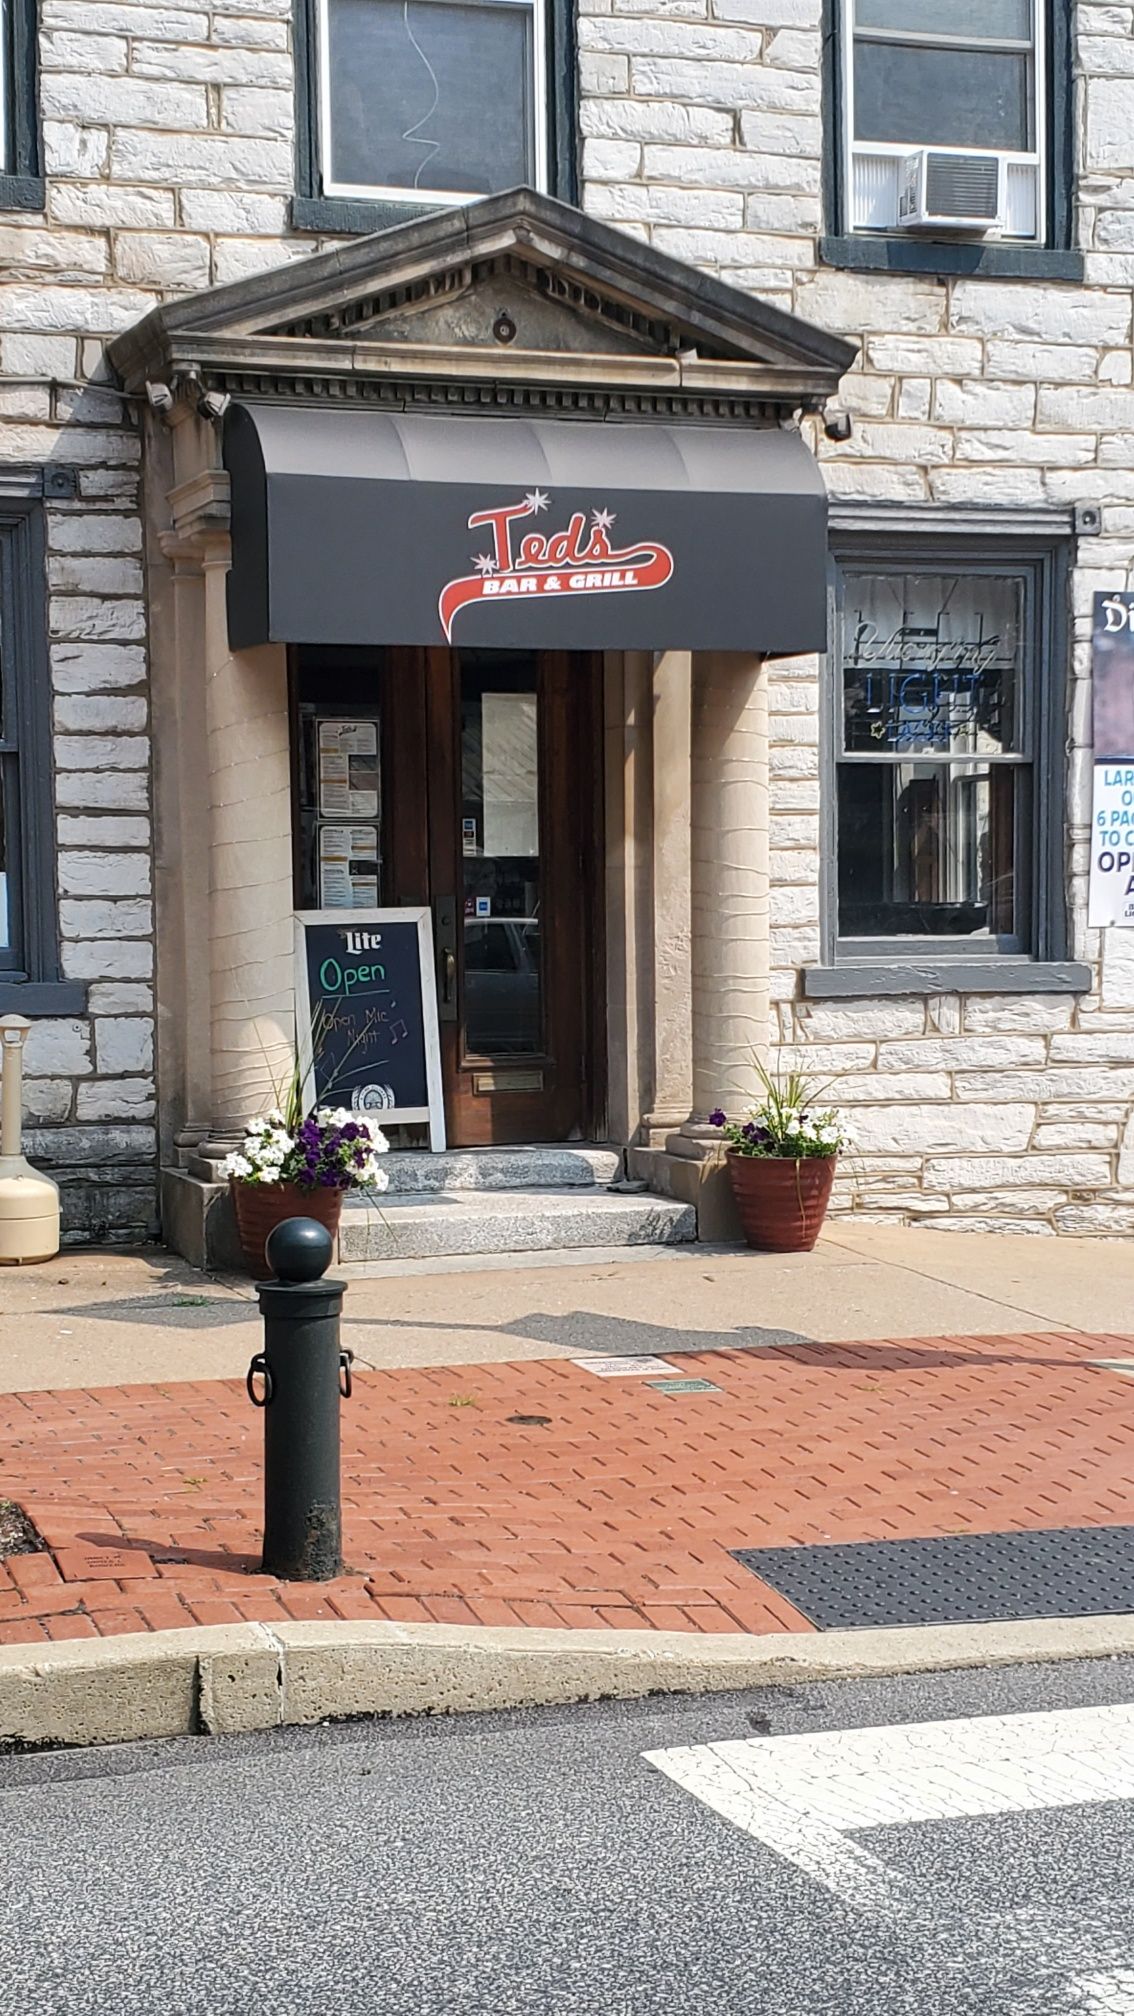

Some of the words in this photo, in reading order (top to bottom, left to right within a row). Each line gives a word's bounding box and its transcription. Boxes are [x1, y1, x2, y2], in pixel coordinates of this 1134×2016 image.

[482, 578, 537, 595] BAR
[543, 575, 561, 591] &
[569, 571, 638, 588] GRILL
[1097, 810, 1106, 827] 6
[1099, 830, 1121, 847] TO
[1097, 851, 1134, 873] OP
[345, 932, 382, 955] Lite
[320, 958, 385, 996] Open
[323, 1012, 356, 1033] Open
[365, 1007, 391, 1025] Mic
